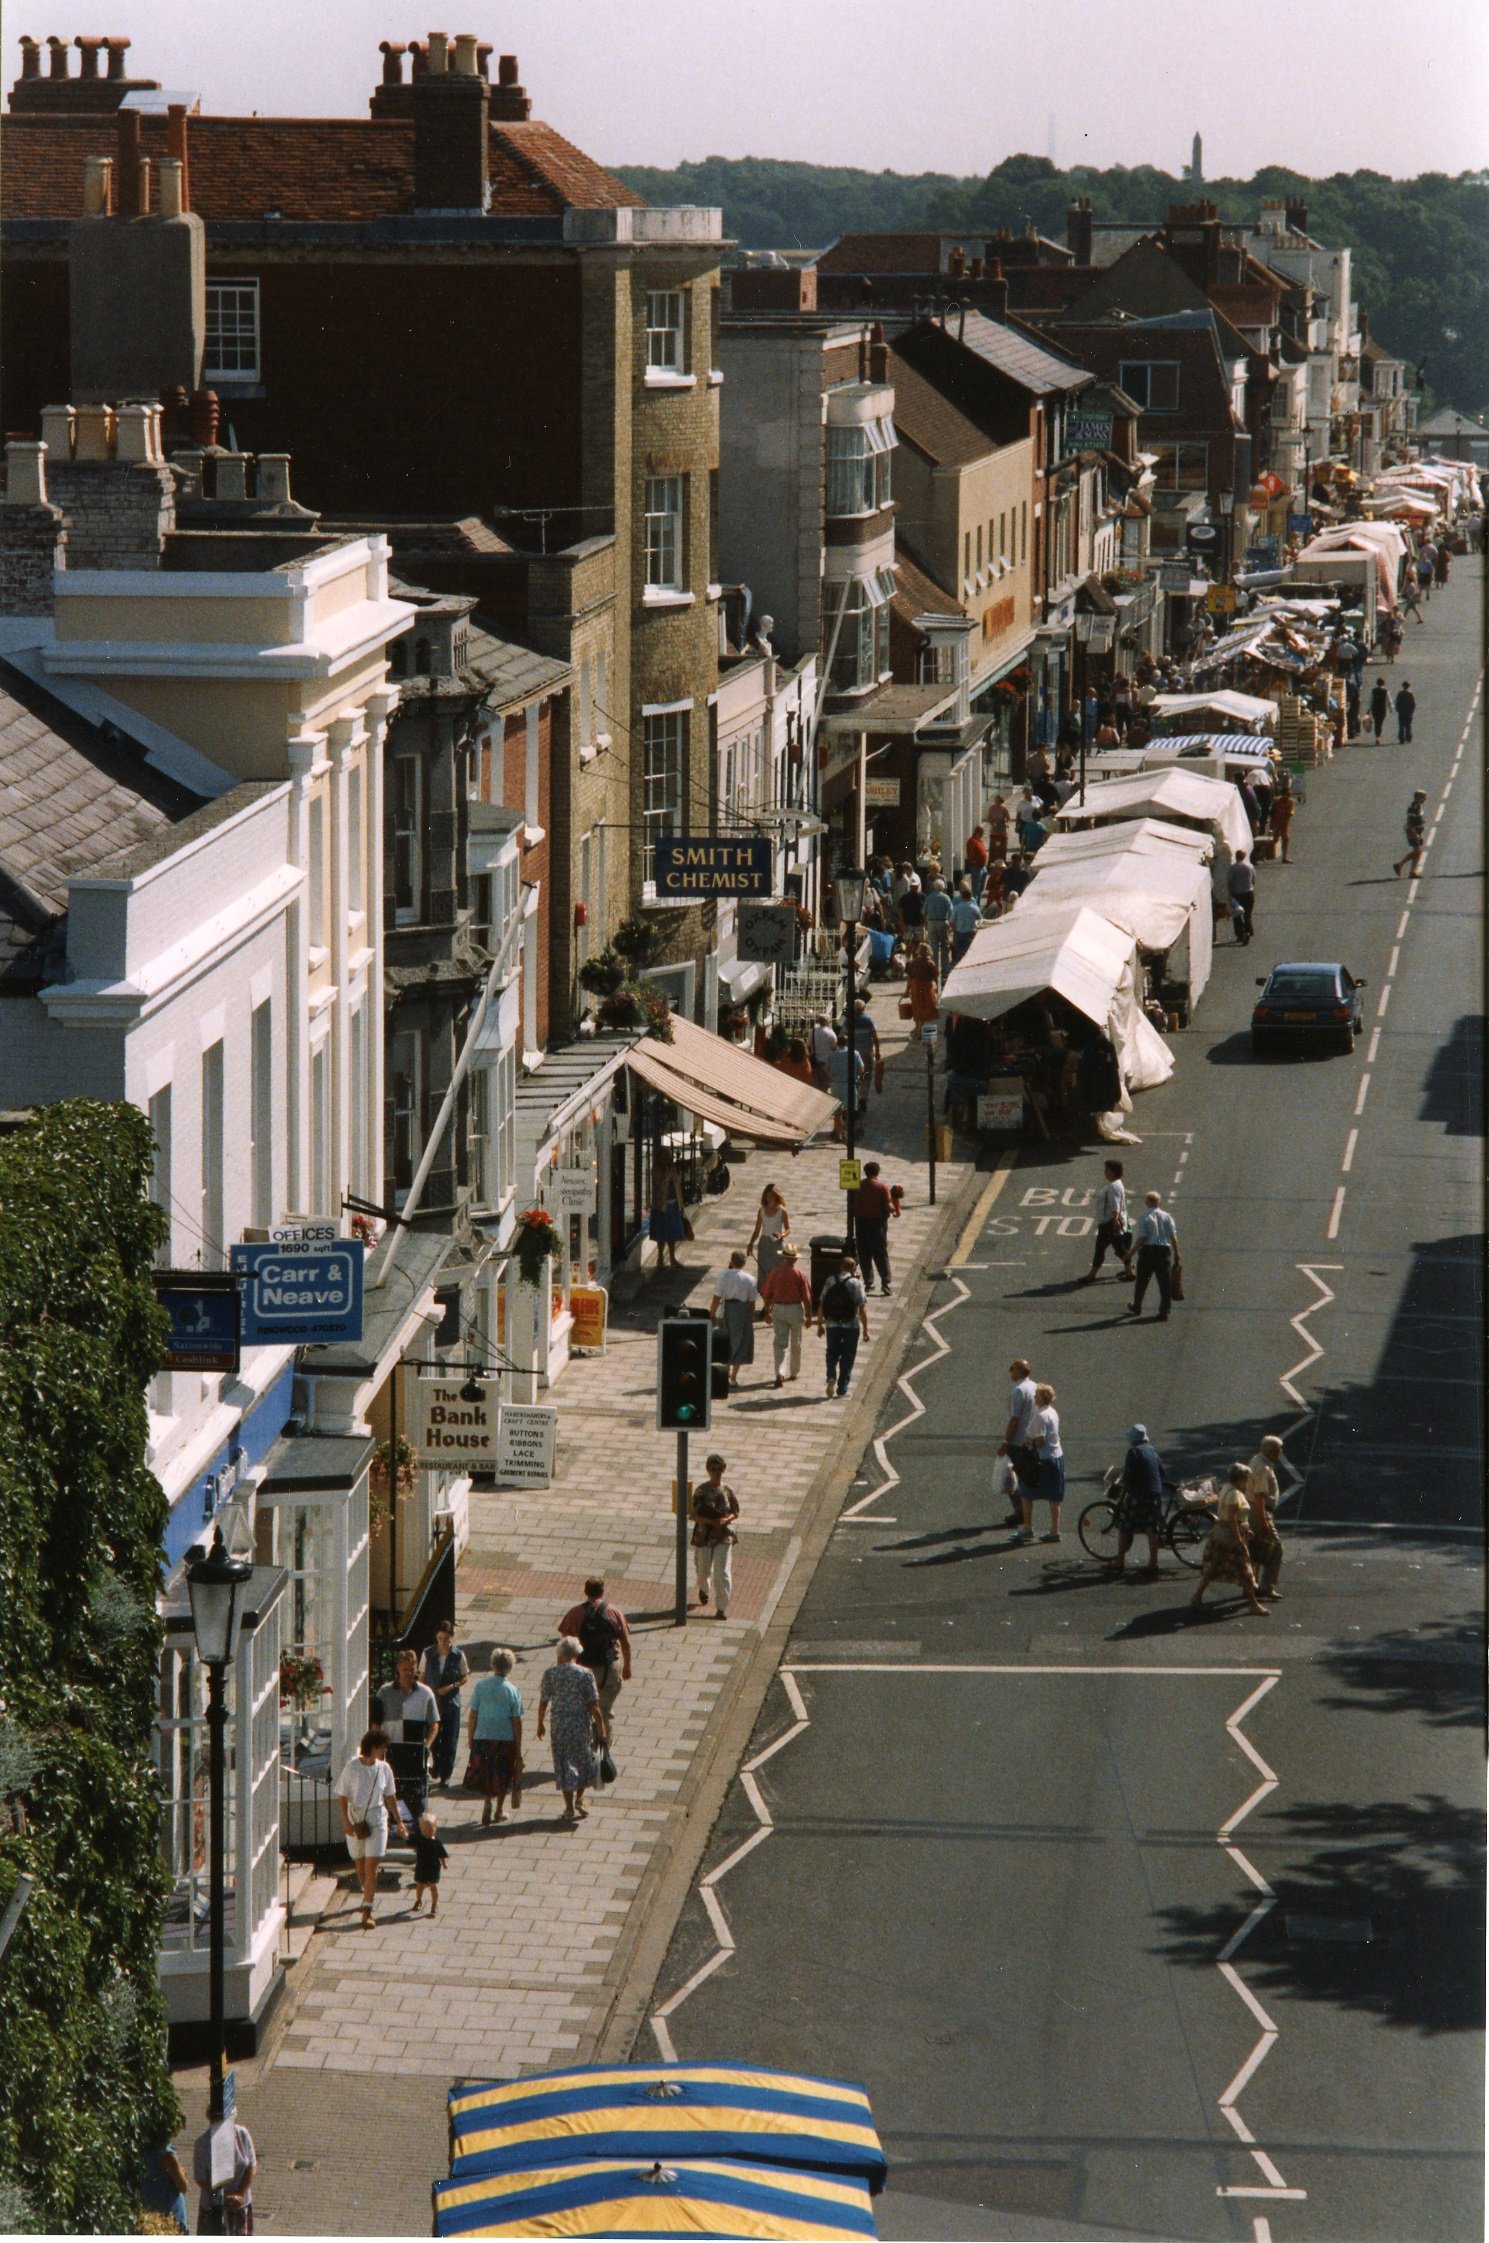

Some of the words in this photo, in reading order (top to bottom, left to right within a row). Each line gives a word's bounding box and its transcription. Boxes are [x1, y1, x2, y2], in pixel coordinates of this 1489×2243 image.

[671, 847, 753, 866] SMITH
[666, 872, 763, 888] CHEMIST
[744, 910, 786, 931] OXFAM
[744, 937, 787, 957] OXFAM
[273, 1227, 335, 1242] OFFICES
[280, 1243, 309, 1253] 1690
[262, 1265, 320, 1284] Carr
[327, 1264, 342, 1282] &
[236, 1254, 248, 1336] ENUIRIES
[262, 1287, 344, 1306] Neave
[433, 1388, 458, 1402] The
[430, 1405, 487, 1425] Bank
[426, 1428, 490, 1448] House
[509, 1429, 544, 1438] BUTTONS
[509, 1439, 543, 1448] RIBBONS
[513, 1450, 535, 1458] LACE
[420, 1462, 470, 1470] RESTAURANT
[479, 1463, 495, 1471] BAR
[505, 1459, 545, 1469] TRIMMING
